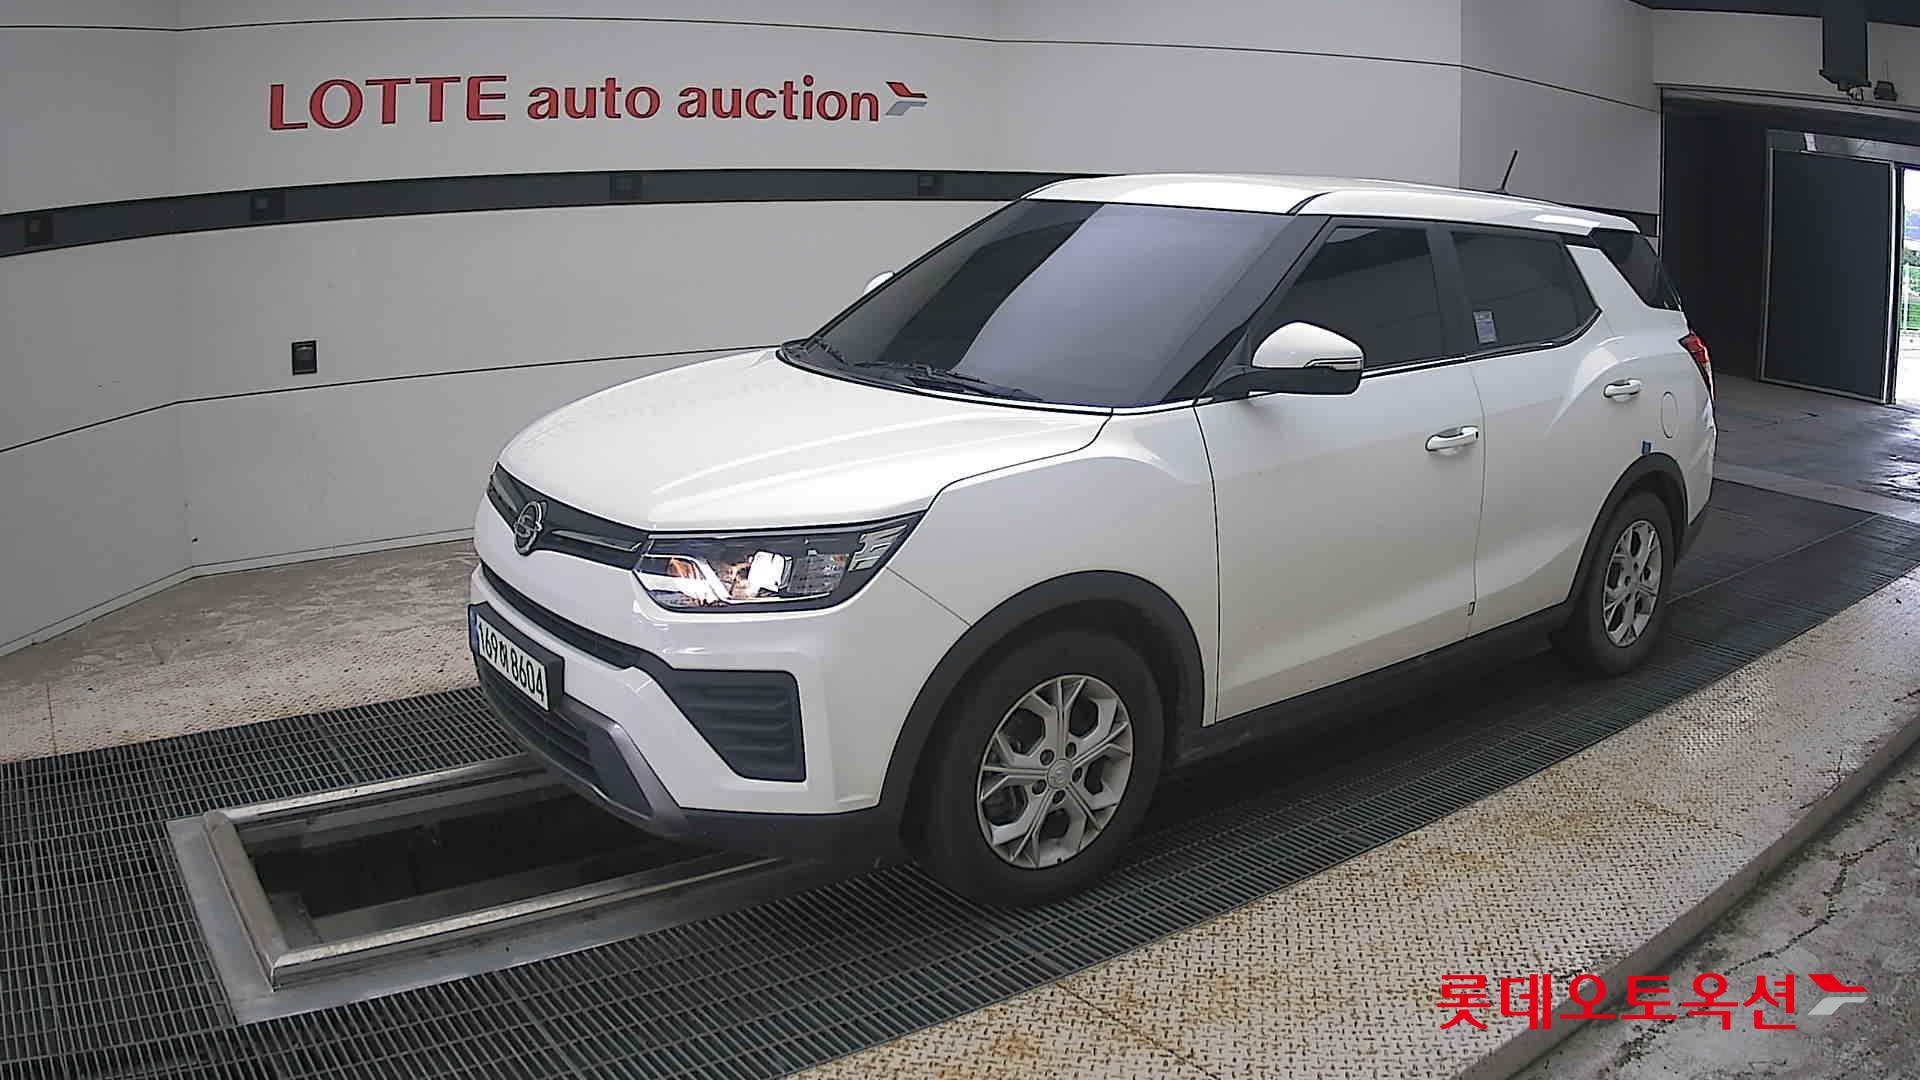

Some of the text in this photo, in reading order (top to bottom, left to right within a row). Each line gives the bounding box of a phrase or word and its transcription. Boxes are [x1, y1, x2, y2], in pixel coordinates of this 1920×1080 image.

[268, 74, 880, 131] LOTTE auto auction
[510, 647, 545, 702] 8604
